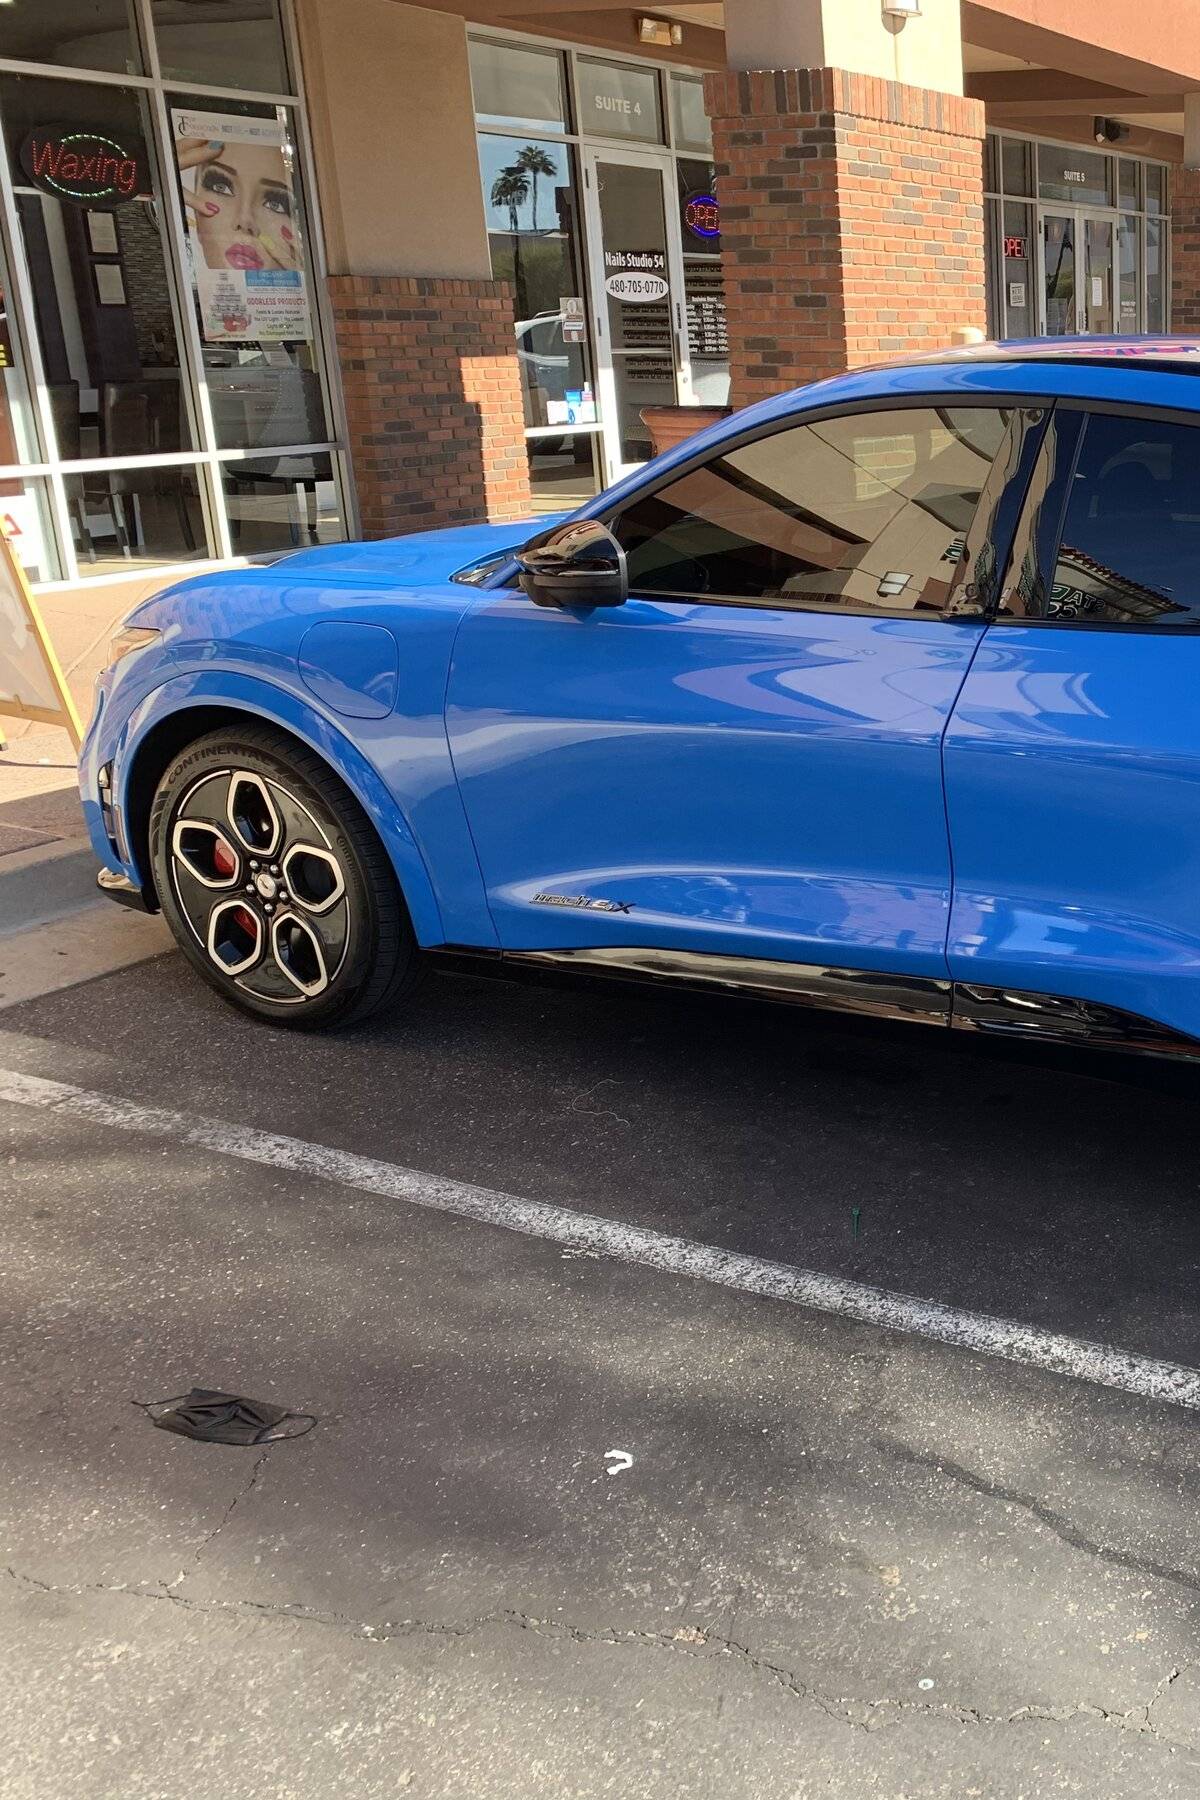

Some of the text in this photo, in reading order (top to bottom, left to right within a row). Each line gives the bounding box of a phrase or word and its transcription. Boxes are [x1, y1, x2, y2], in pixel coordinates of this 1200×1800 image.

[594, 95, 642, 116] SUITE 4
[32, 139, 137, 194] Waxing
[1063, 170, 1080, 181] SUITE
[685, 203, 719, 229] OPE
[604, 251, 664, 269] Nails Studio 54
[609, 279, 664, 294] 480-705-0770
[167, 743, 273, 785] CONTINENTAL
